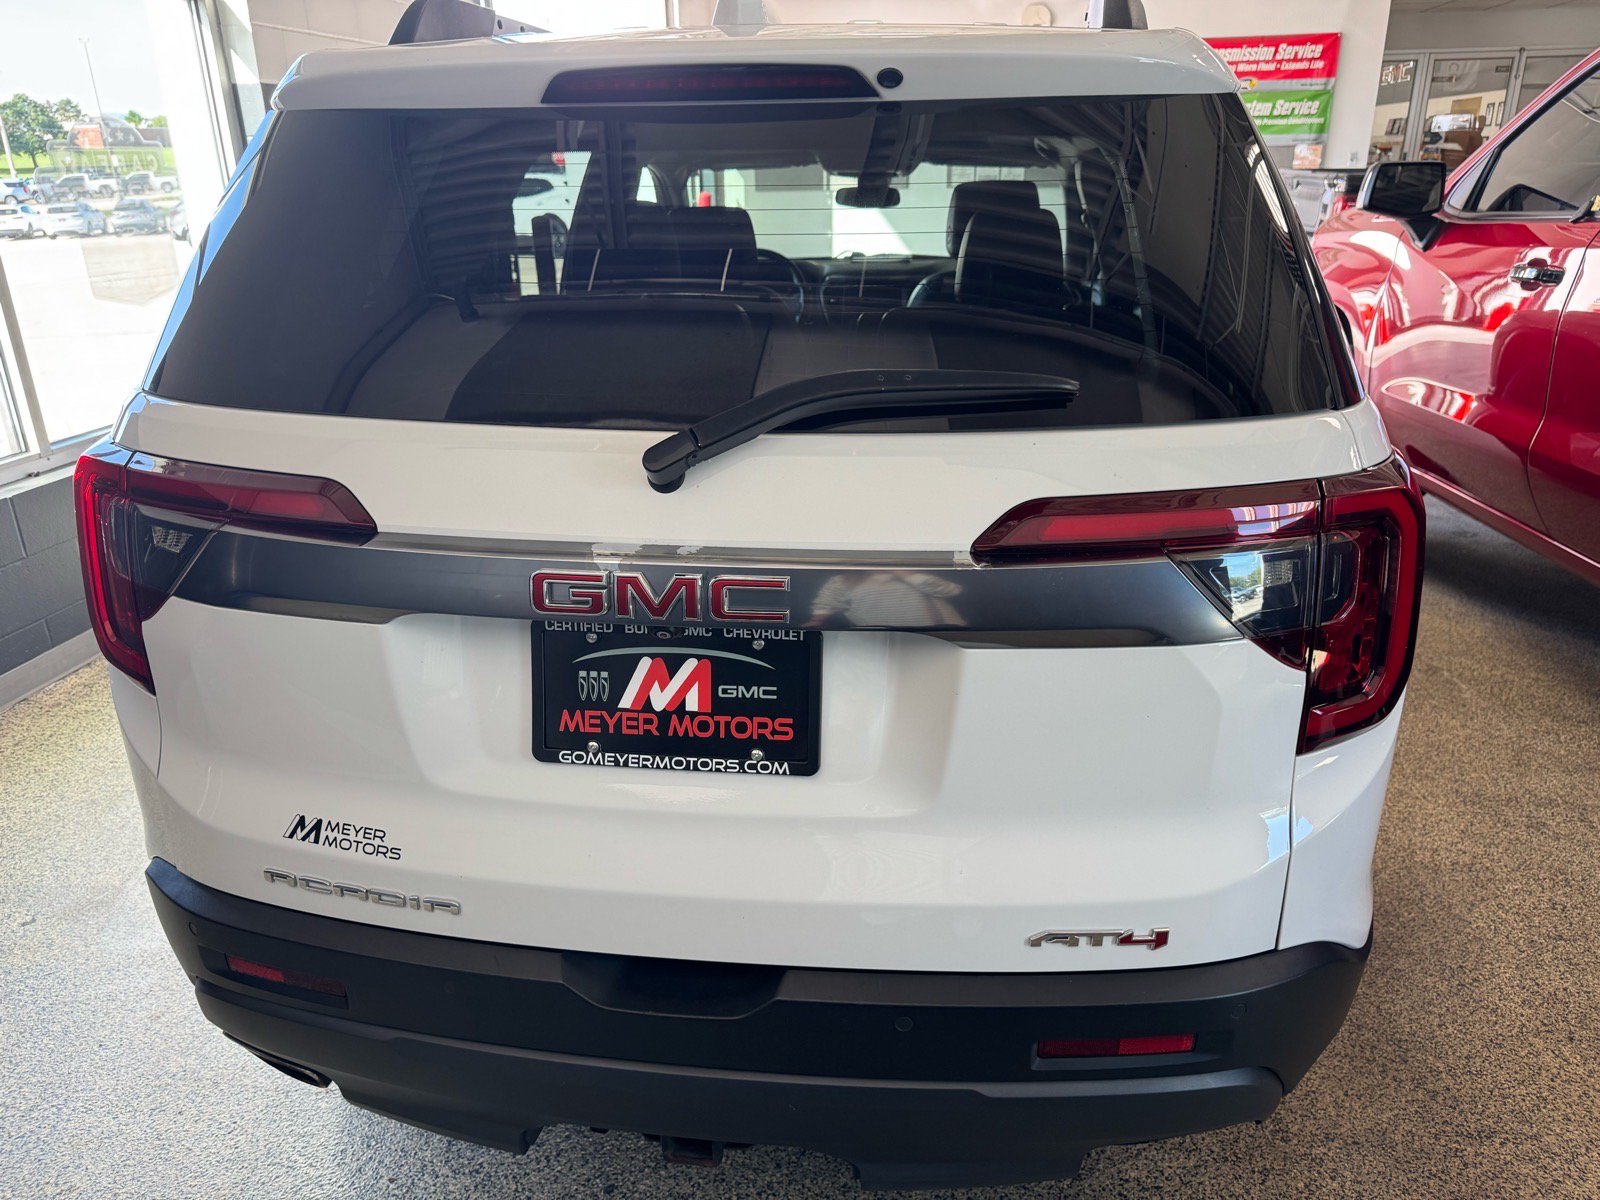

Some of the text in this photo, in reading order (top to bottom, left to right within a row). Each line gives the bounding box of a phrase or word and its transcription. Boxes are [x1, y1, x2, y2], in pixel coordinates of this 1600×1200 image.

[1213, 42, 1323, 62] nsmission Service
[1273, 99, 1319, 116] Service
[530, 569, 791, 624] GMC
[545, 620, 613, 633] CERTIFIED
[625, 624, 648, 635] BUI
[723, 627, 807, 641] CHEVROLET
[718, 685, 777, 699] GMC
[559, 709, 794, 741] MEYER MOTORS
[558, 751, 790, 775] GOMEYERMOTORS.COM
[324, 820, 386, 842] MEYER
[322, 834, 402, 860] MOTORS
[263, 867, 461, 915] ACADIA
[1025, 927, 1170, 951] AT4
